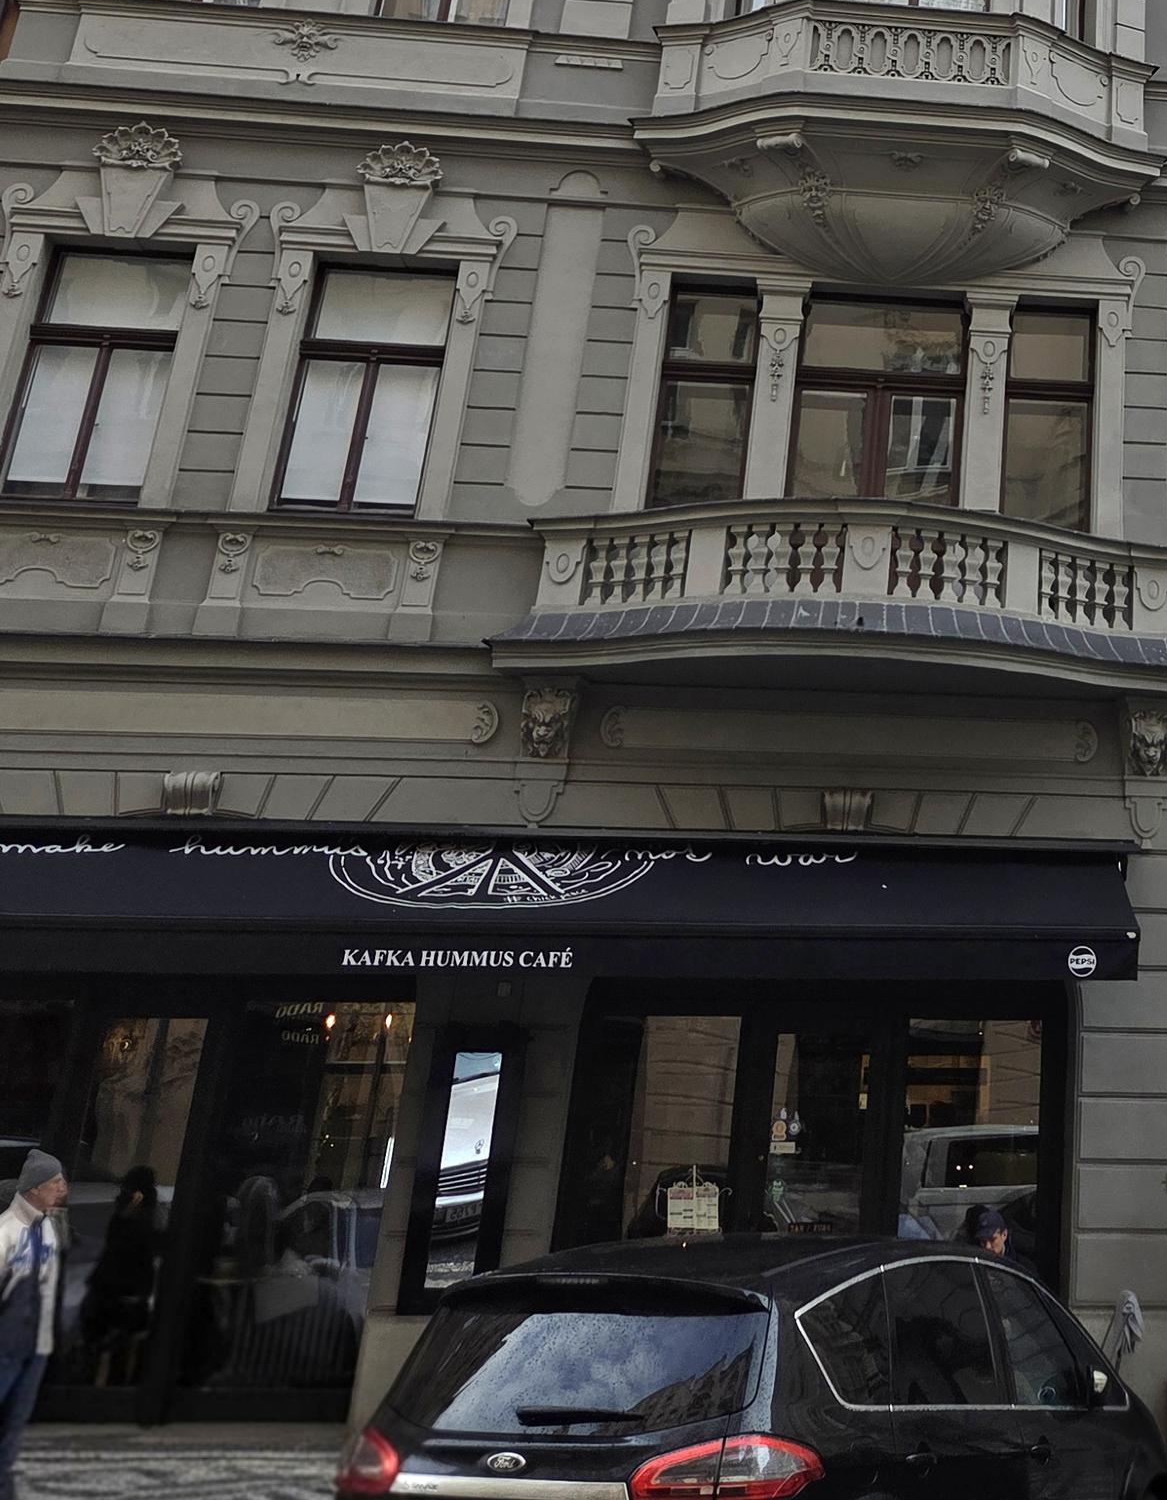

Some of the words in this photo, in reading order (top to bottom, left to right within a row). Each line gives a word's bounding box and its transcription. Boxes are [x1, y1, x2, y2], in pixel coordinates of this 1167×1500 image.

[0, 834, 125, 854] make
[168, 834, 369, 857] hummus
[341, 949, 415, 967] KAFKA
[419, 950, 515, 968] HUMMUS
[518, 947, 574, 969] CAFÉ
[493, 1455, 515, 1468] Ford
